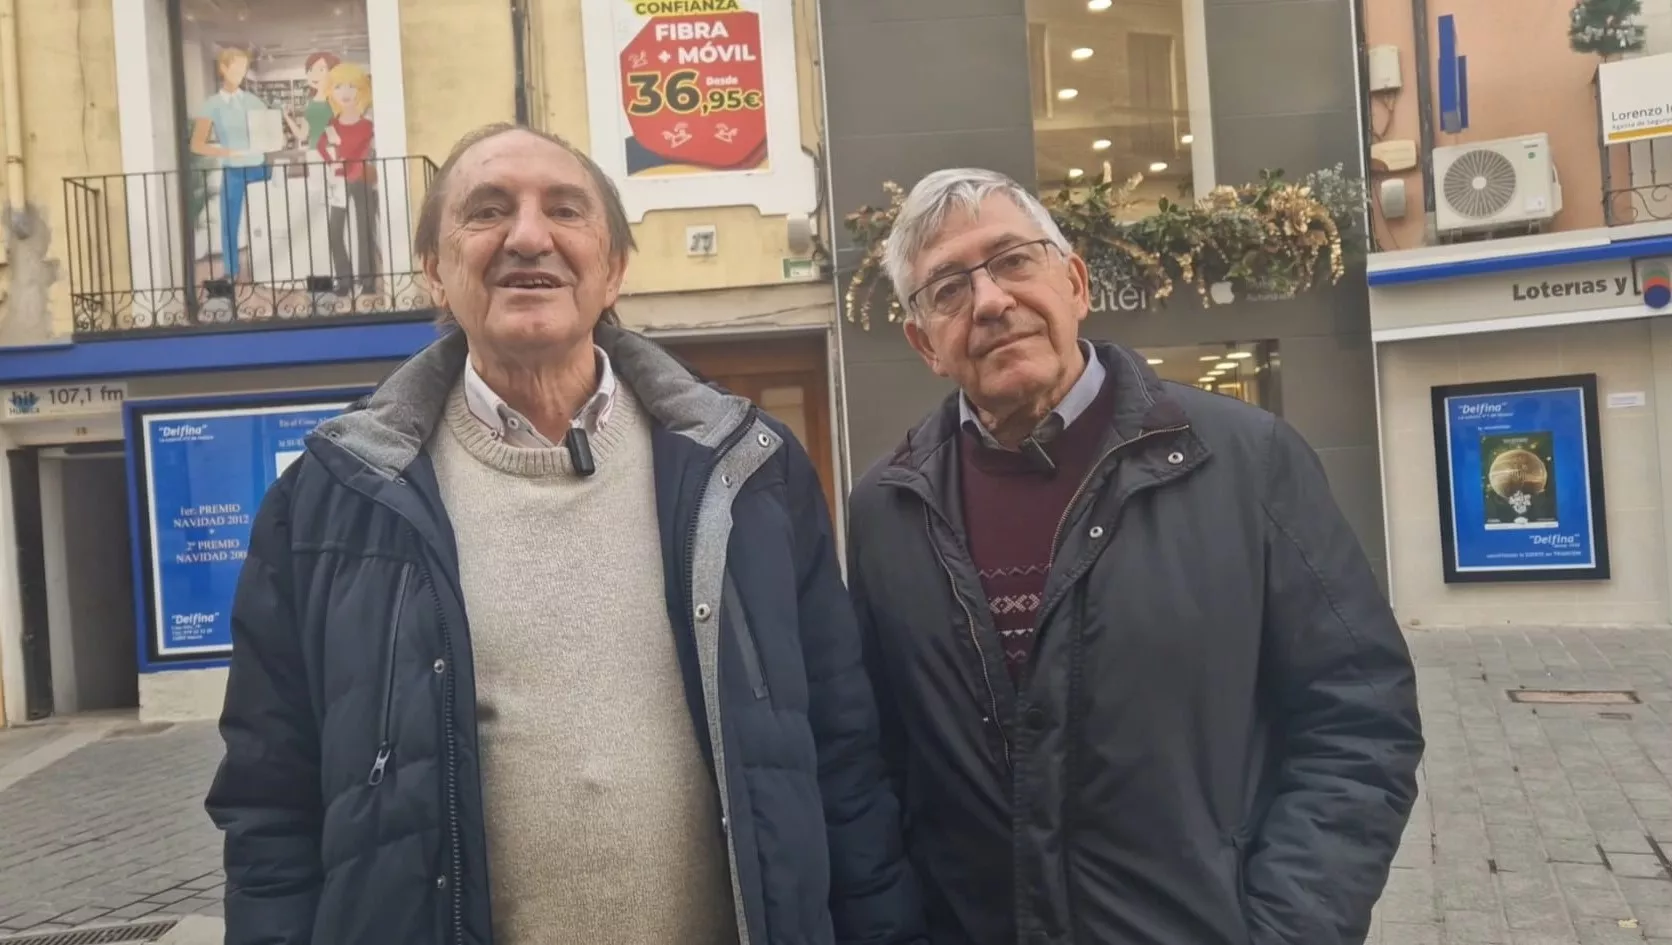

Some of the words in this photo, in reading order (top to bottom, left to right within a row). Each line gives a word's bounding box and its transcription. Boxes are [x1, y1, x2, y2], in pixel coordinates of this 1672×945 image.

[635, 0, 739, 15] CONFIANZA
[655, 21, 729, 41] FIBRA
[658, 51, 671, 63] +
[678, 42, 757, 65] MÓVIL
[706, 75, 739, 87] Desde
[1611, 106, 1663, 121] Lorenzo
[1614, 276, 1627, 296] y
[48, 386, 93, 406] 107,1
[100, 384, 125, 401] fm
[199, 503, 241, 515] PREMIO
[173, 516, 225, 529] NAVIDAD
[226, 513, 250, 526] 2012
[197, 538, 240, 550] PREMIO
[176, 550, 228, 564] NAVIDAD
